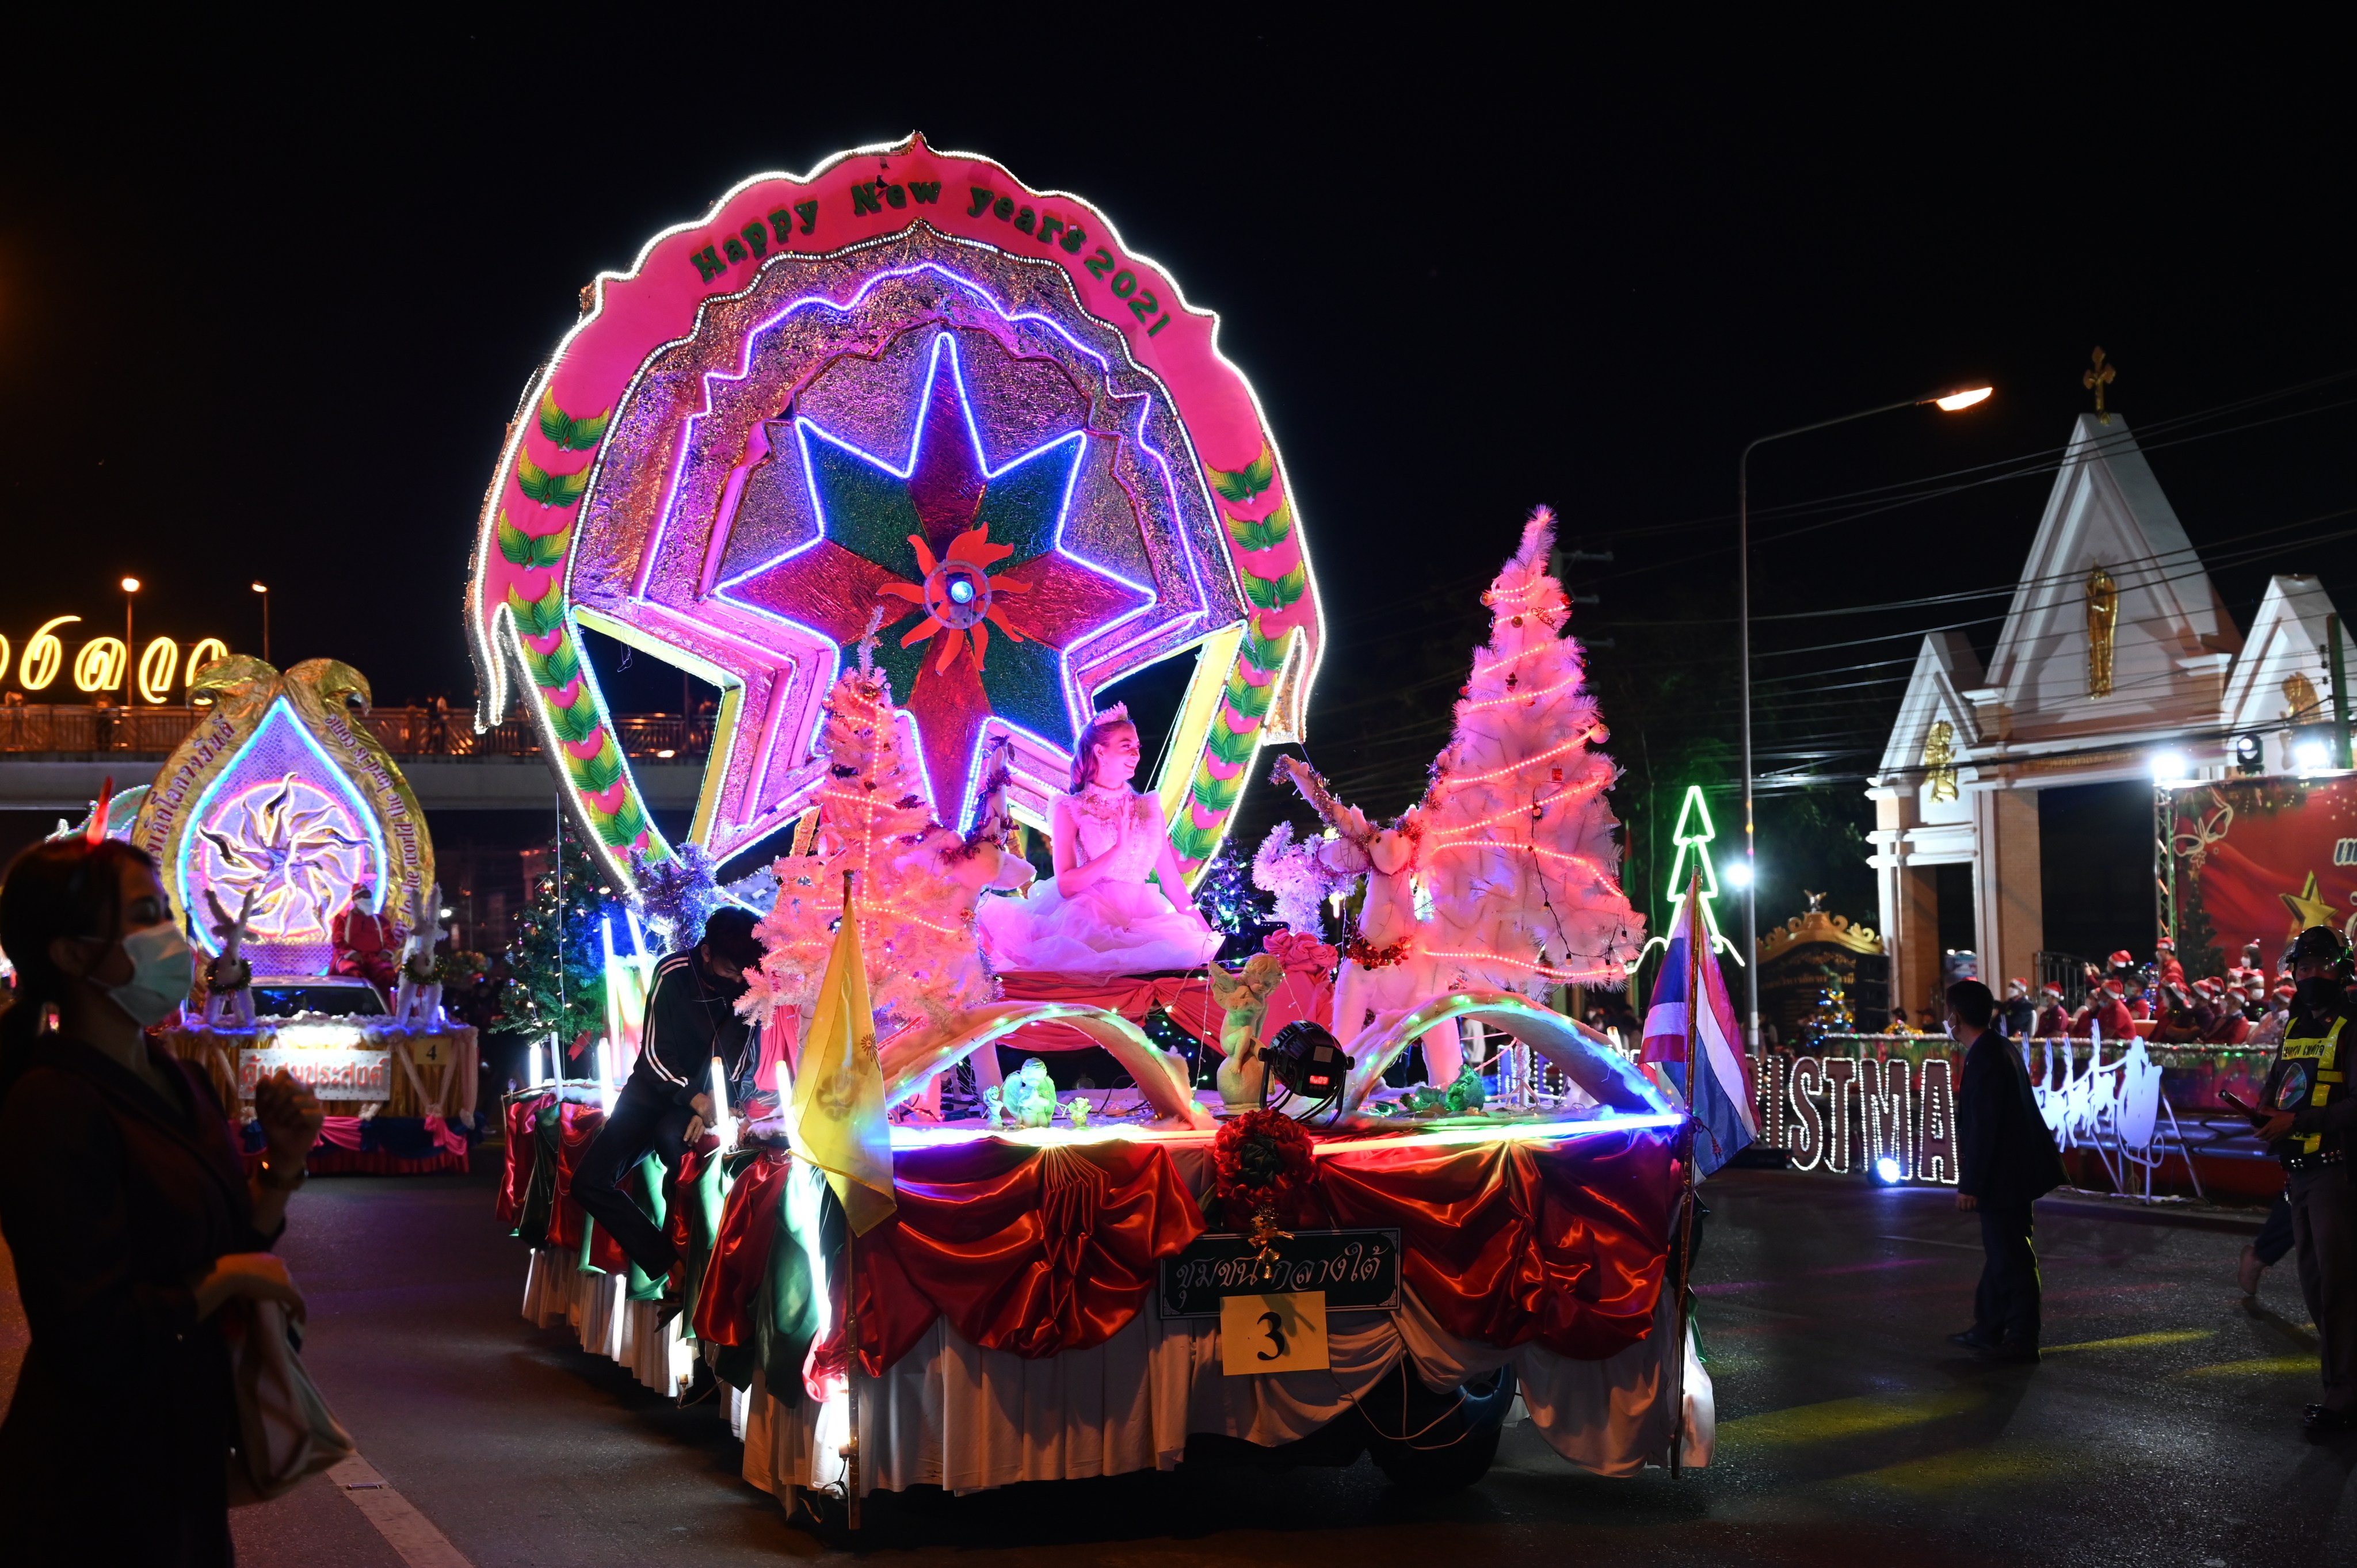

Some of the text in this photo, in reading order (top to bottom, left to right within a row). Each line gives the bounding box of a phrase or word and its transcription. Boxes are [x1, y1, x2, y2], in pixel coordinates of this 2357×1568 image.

[690, 181, 1170, 337] Happy New years 2021
[324, 714, 357, 749] come
[353, 746, 371, 765] is
[360, 760, 394, 793] lord
[386, 793, 406, 818] the
[394, 822, 418, 865] world
[426, 1044, 437, 1060] 4
[1256, 1311, 1286, 1361] 3
